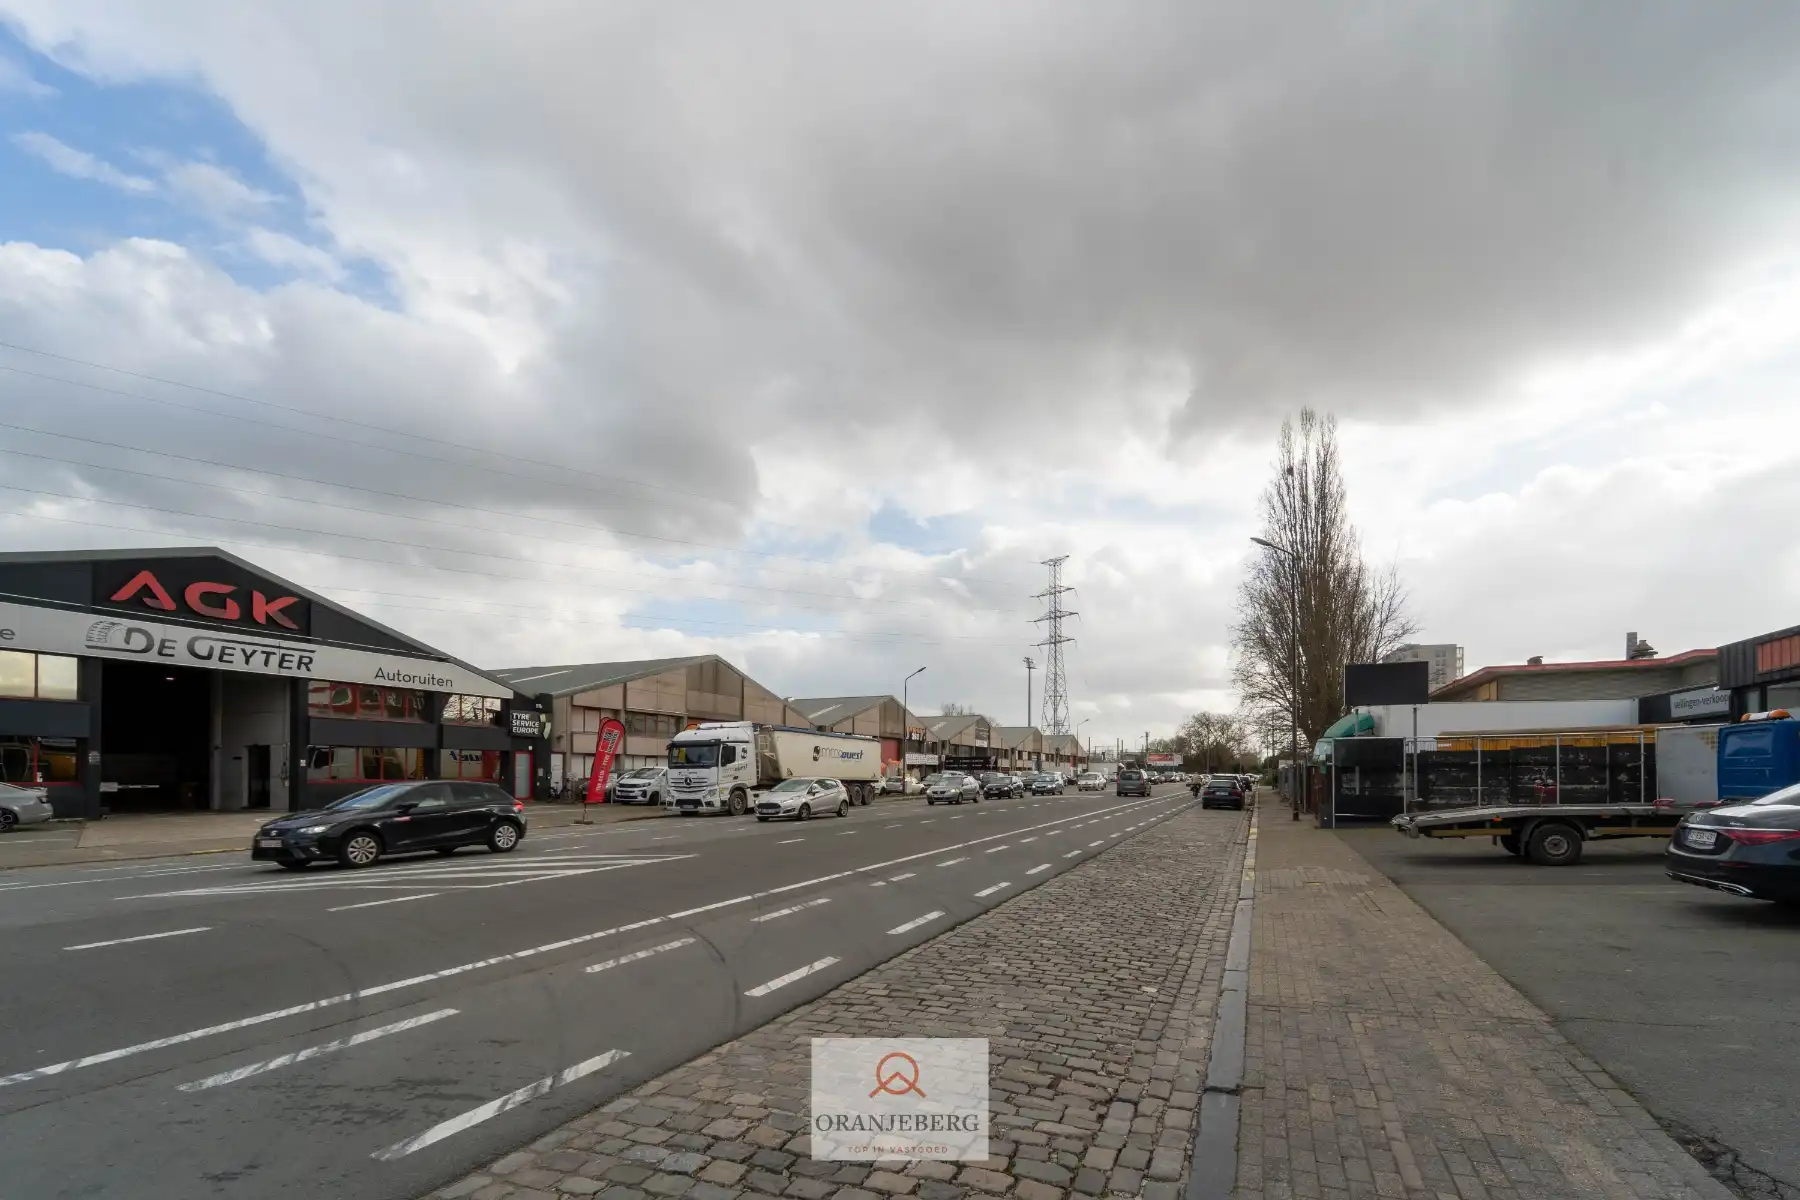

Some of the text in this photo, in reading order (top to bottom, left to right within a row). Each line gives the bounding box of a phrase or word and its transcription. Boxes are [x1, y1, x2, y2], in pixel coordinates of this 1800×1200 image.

[111, 570, 299, 630] AGK
[374, 667, 453, 688] Autoruiten
[512, 712, 530, 720] TYRE
[512, 719, 539, 728] SERVICE
[512, 726, 539, 735] EUROPE
